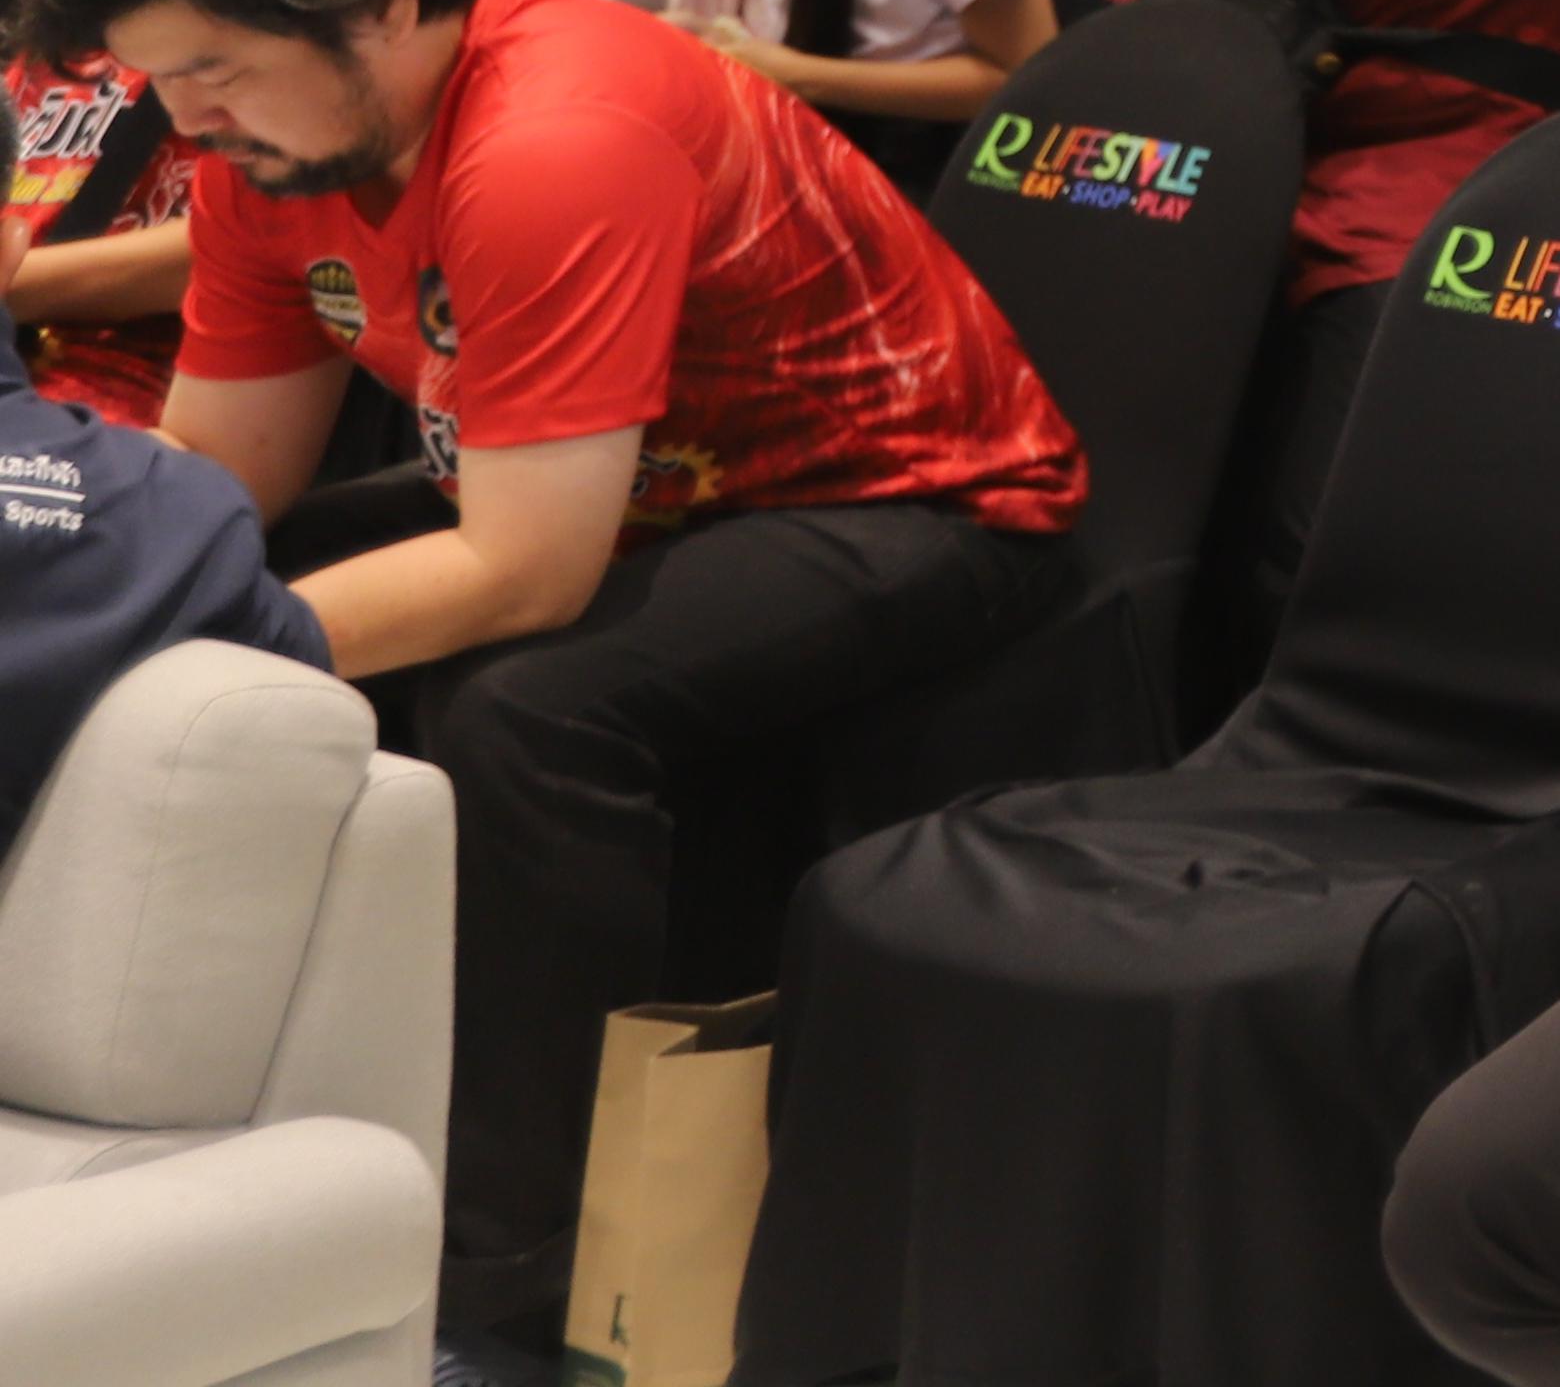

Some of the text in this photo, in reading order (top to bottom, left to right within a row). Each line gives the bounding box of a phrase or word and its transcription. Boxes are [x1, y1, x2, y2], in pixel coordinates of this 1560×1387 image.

[974, 112, 1212, 196] R LIFESTYLE
[1021, 170, 1065, 200] EAT
[1070, 179, 1131, 210] SHOP
[1135, 189, 1193, 224] PLAY
[1429, 224, 1495, 300] R
[1493, 291, 1545, 324] EAT
[4, 498, 85, 532] Sports
